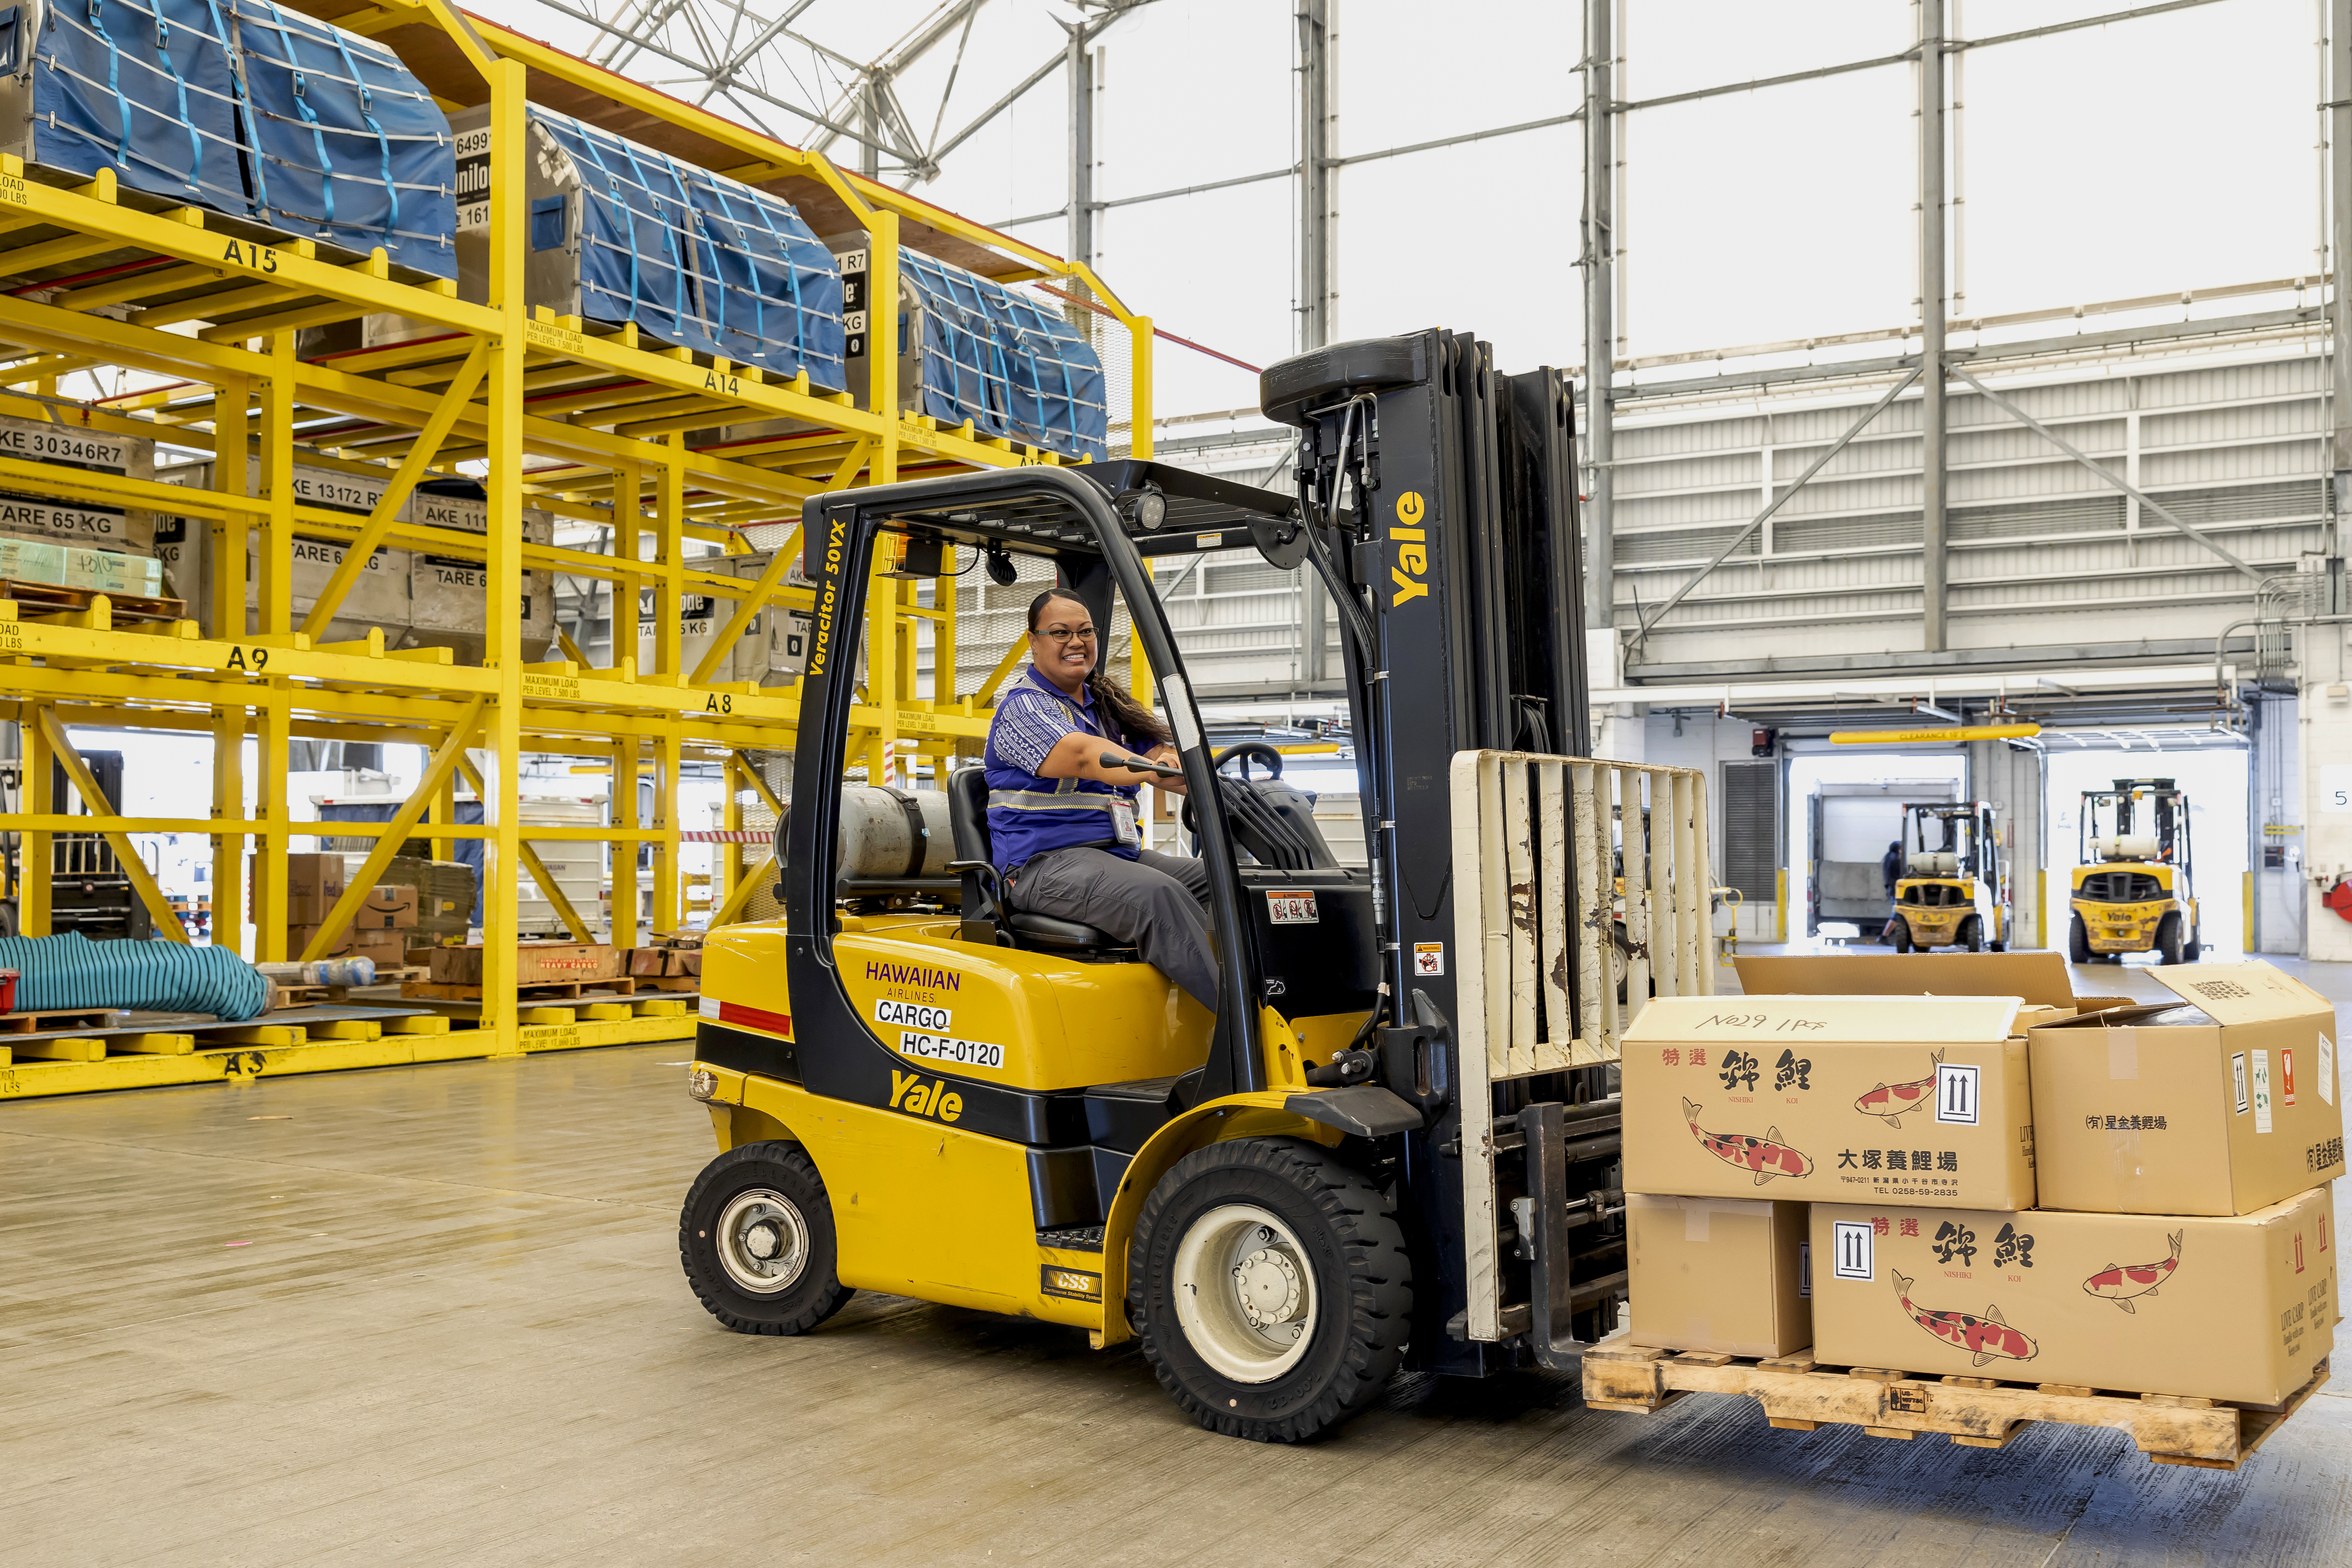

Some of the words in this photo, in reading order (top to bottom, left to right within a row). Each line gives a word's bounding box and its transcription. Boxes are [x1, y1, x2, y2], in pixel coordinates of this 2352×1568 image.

[457, 132, 491, 154] 6499
[11, 191, 27, 205] LBS
[223, 239, 279, 273] A15
[848, 254, 864, 269] R7
[529, 322, 563, 338] MAXIMUM
[565, 331, 582, 343] LOAD
[527, 331, 538, 341] PER
[539, 334, 556, 346] LEVEL
[574, 344, 584, 354] LBS
[704, 371, 739, 397] A14
[900, 423, 923, 435] MAXIMUM
[924, 430, 936, 438] LOAD
[318, 484, 361, 504] 13172
[0, 504, 46, 526] ARE
[53, 512, 74, 530] 65
[85, 516, 111, 533] KG
[426, 507, 457, 524] AKE
[292, 543, 330, 562] ARE
[1390, 490, 1429, 608] Yale
[435, 569, 474, 586] TARE
[809, 580, 836, 675] Veracitor
[825, 518, 846, 575] 50VX
[690, 622, 707, 634] KG
[6, 637, 22, 649] LBS
[226, 646, 269, 672] A9
[525, 675, 559, 686] MAXIMUM
[561, 679, 578, 688] LOAD
[523, 685, 533, 694] PER
[535, 686, 551, 696] LEVEL
[570, 689, 580, 698] LBS
[899, 712, 921, 721] MAXIMUM
[906, 720, 916, 729] LEVEL
[2335, 791, 2347, 805] 5
[866, 961, 960, 992] HAWAIIAN
[879, 1001, 947, 1030] CARGO
[524, 1029, 557, 1039] MAXIMUM
[560, 1028, 577, 1036] LOAD
[903, 1033, 1000, 1066] HC-F-0120
[1662, 1047, 1707, 1066] 特選
[889, 1069, 963, 1122] Yale
[1838, 1148, 1958, 1172] 大塚養鯉場
[1892, 1188, 1958, 1196] 0258-59-2835
[1058, 1273, 1090, 1291] CSS
[1944, 1271, 1972, 1280] NISHIKI
[1043, 1287, 1067, 1295] Continuous
[2281, 1310, 2291, 1331] LIVE
[2292, 1302, 2304, 1323] CARP
